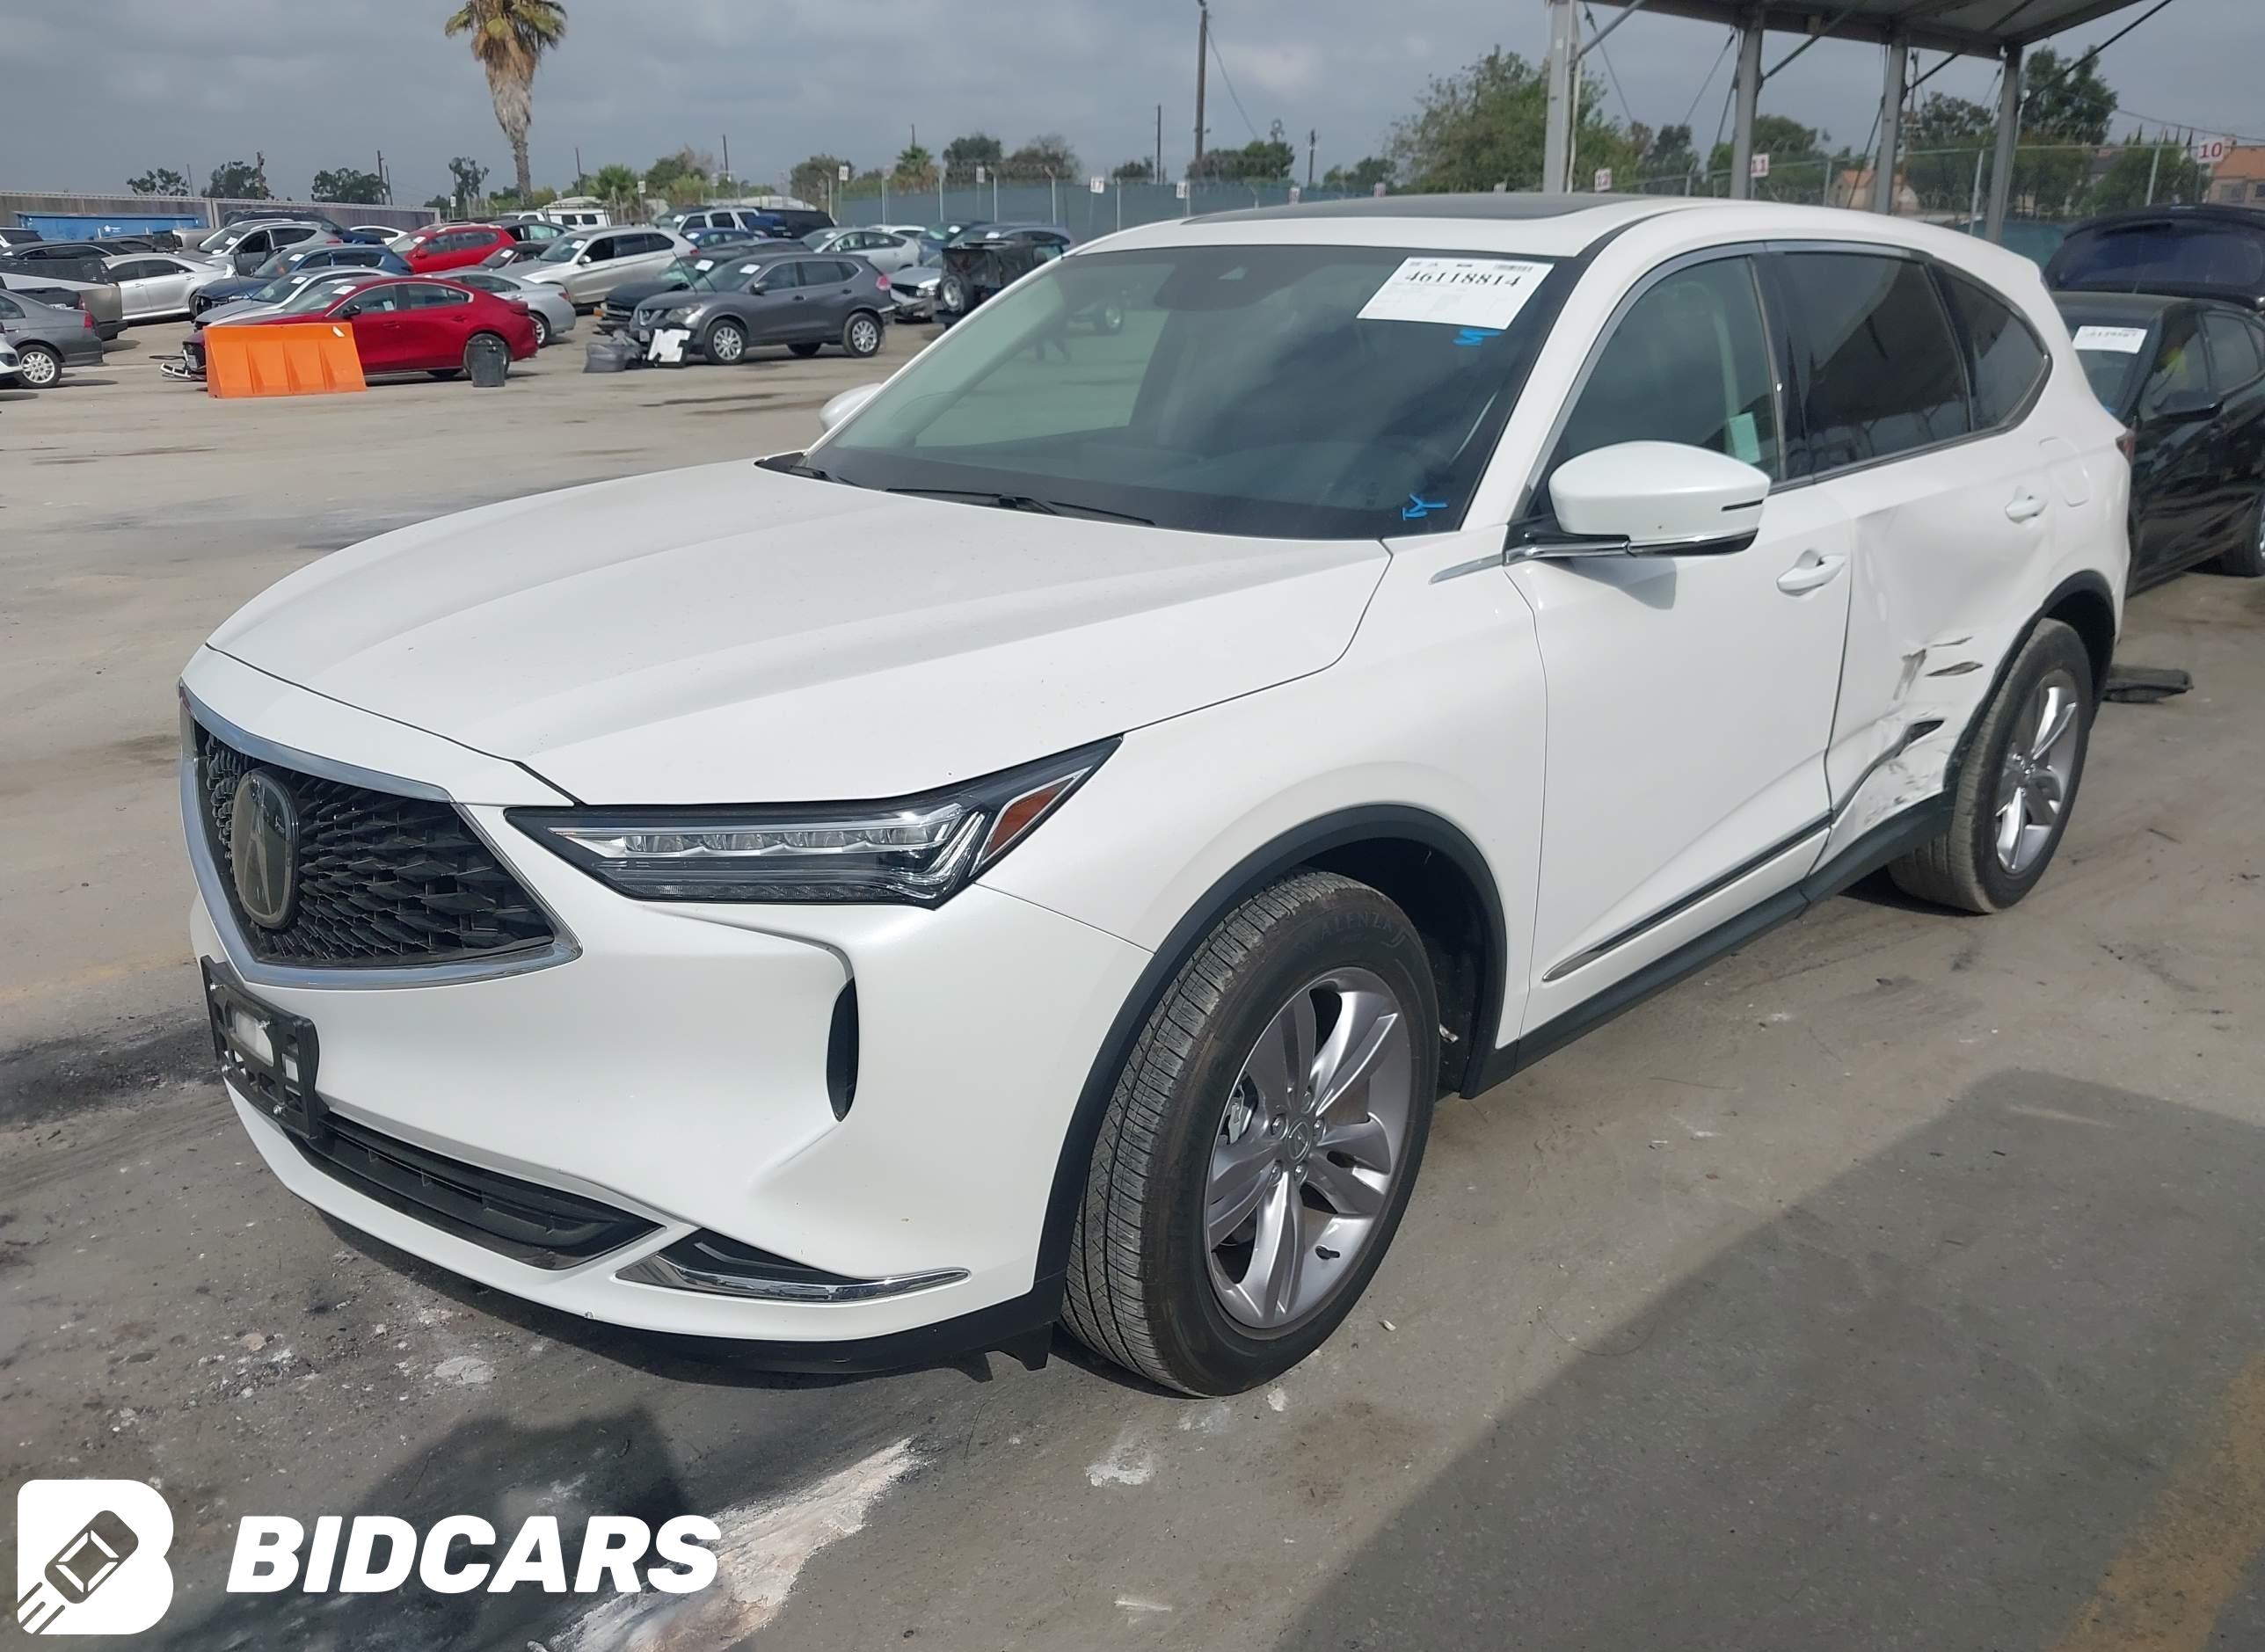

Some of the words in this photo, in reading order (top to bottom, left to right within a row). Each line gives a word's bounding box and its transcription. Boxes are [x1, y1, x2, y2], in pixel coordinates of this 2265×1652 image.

[2200, 142, 2222, 158] 10
[1405, 270, 1521, 287] 46118814
[1322, 910, 1393, 937] ALENZA
